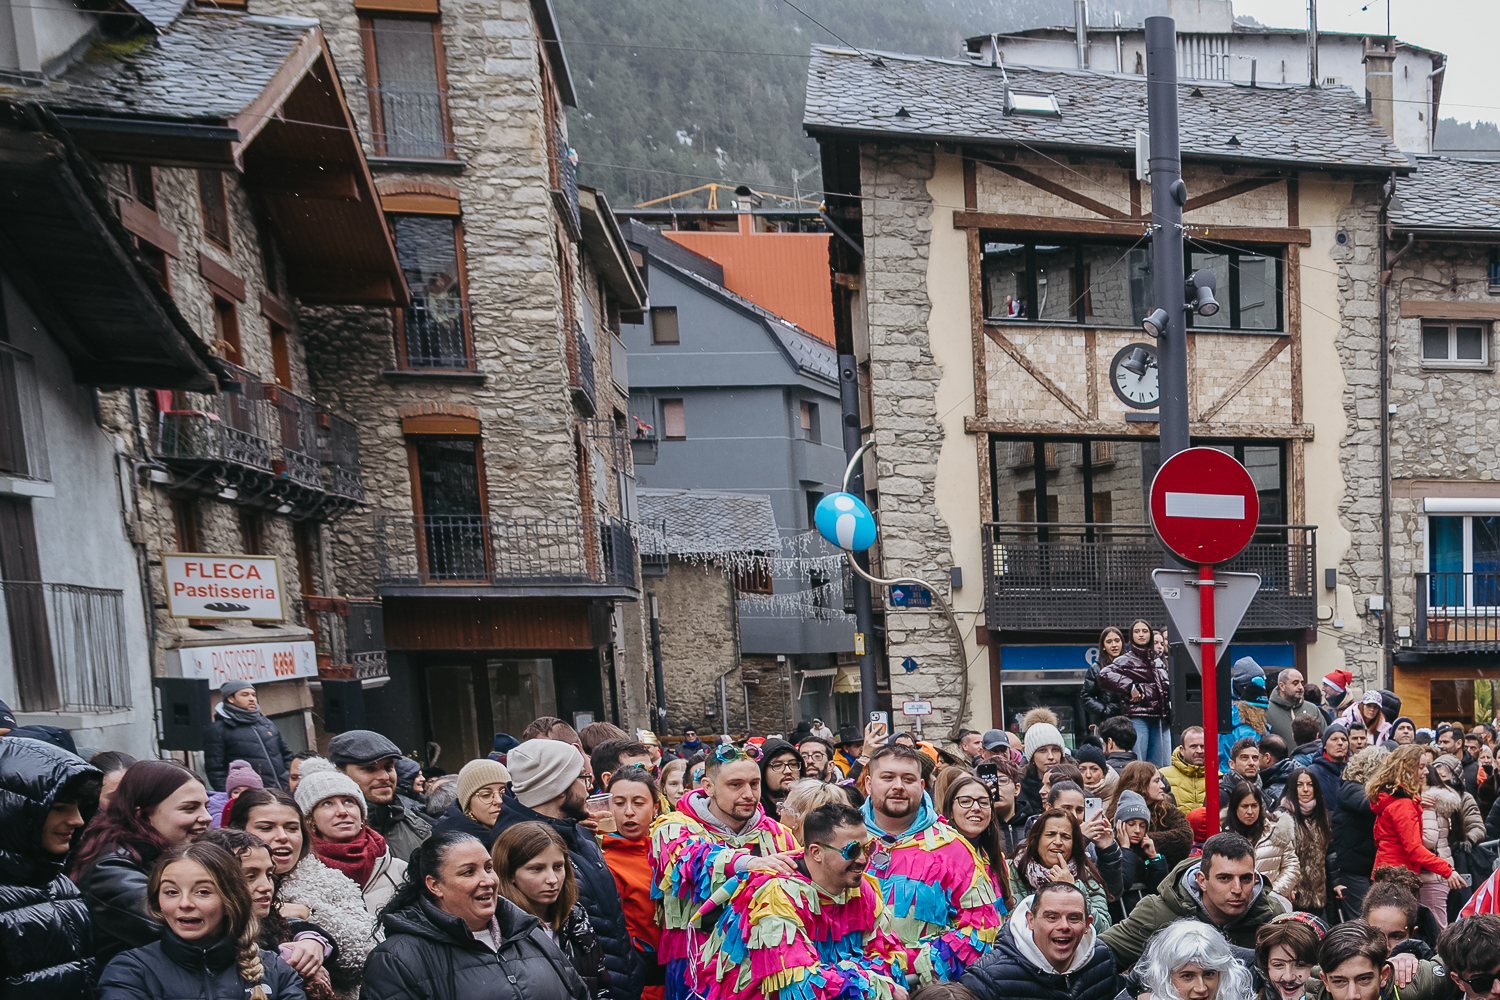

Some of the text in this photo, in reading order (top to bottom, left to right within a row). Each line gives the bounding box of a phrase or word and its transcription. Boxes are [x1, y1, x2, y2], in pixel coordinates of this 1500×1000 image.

[184, 562, 262, 580] FLECA
[173, 582, 276, 600] Pastisseria
[211, 648, 268, 684] PASTISSERIA
